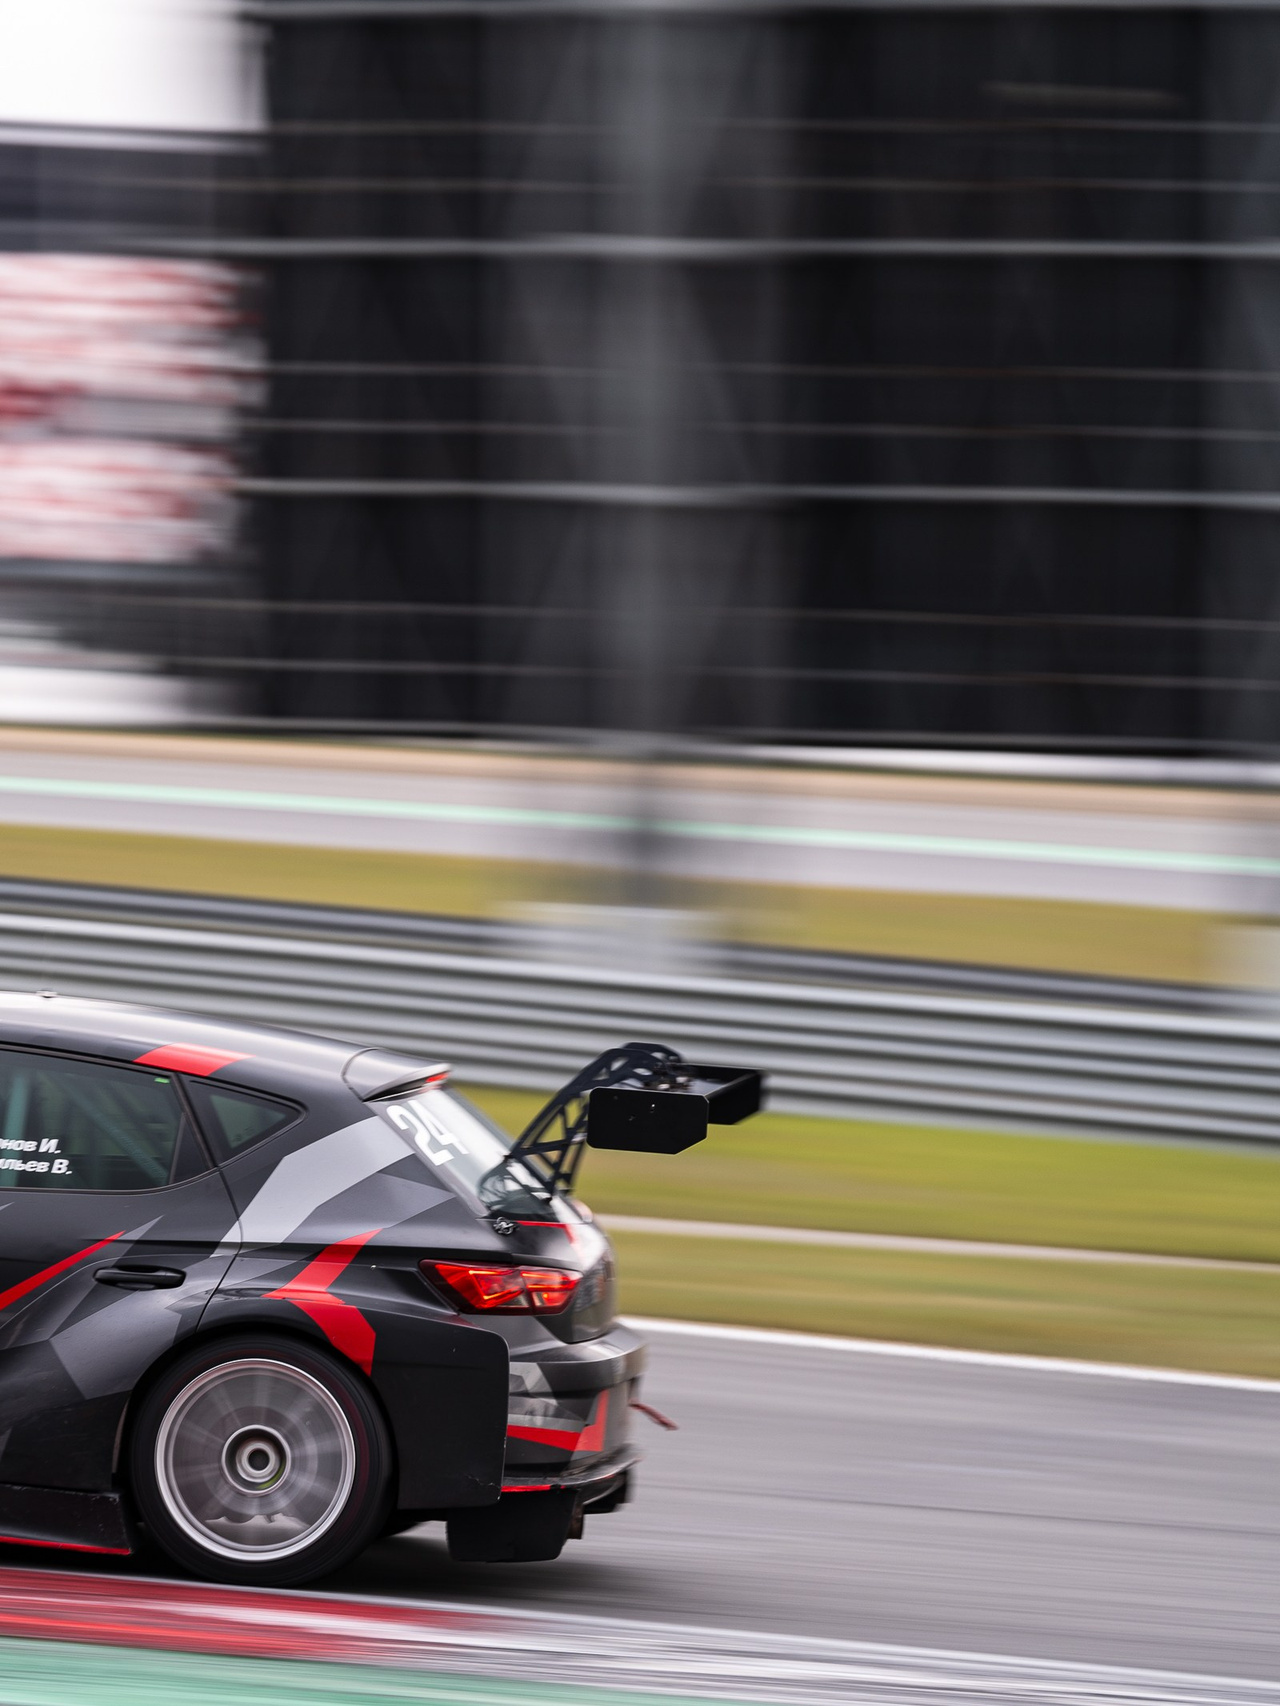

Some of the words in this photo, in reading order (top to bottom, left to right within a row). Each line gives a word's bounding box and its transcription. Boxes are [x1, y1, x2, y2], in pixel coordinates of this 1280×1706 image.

[386, 1100, 469, 1166] 24
[38, 1138, 61, 1154] И.
[50, 1159, 73, 1174] В.
